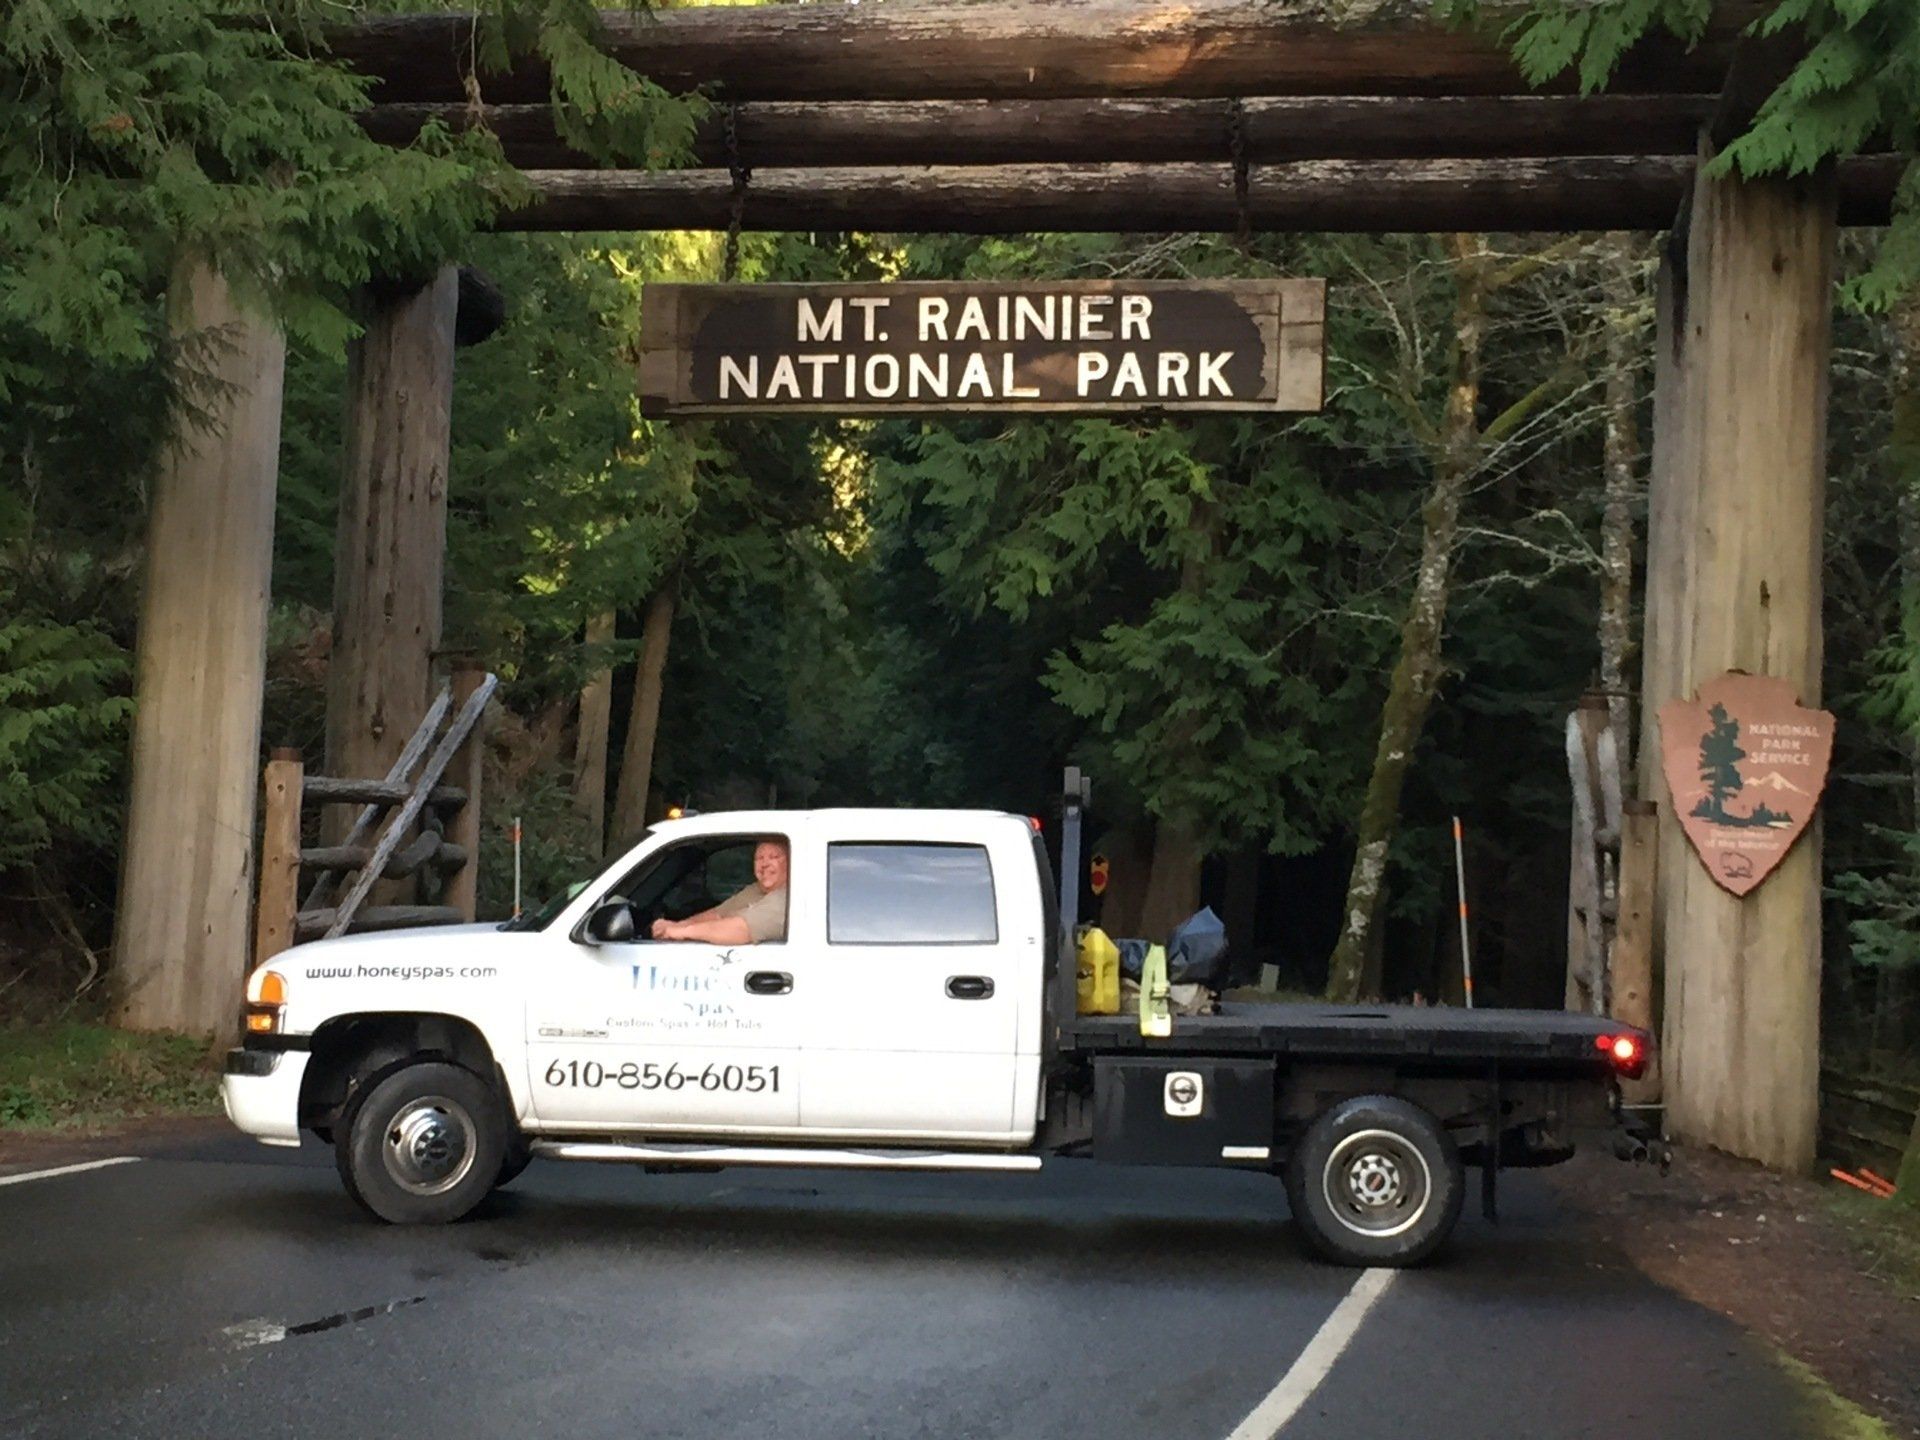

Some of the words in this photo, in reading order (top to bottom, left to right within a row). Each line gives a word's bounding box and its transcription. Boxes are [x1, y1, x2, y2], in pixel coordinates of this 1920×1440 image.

[797, 297, 889, 342] MT.
[918, 295, 1153, 341] RAINIER
[718, 352, 1041, 399] NATIONAL
[1076, 351, 1235, 398] PARK
[1749, 723, 1820, 738] NATIONAL
[1761, 738, 1801, 750] PARK
[1749, 751, 1811, 766] SERVICE
[305, 964, 498, 981] www.honeyspascom
[632, 965, 733, 991] Hone
[544, 1058, 780, 1093] 610-856-6051
